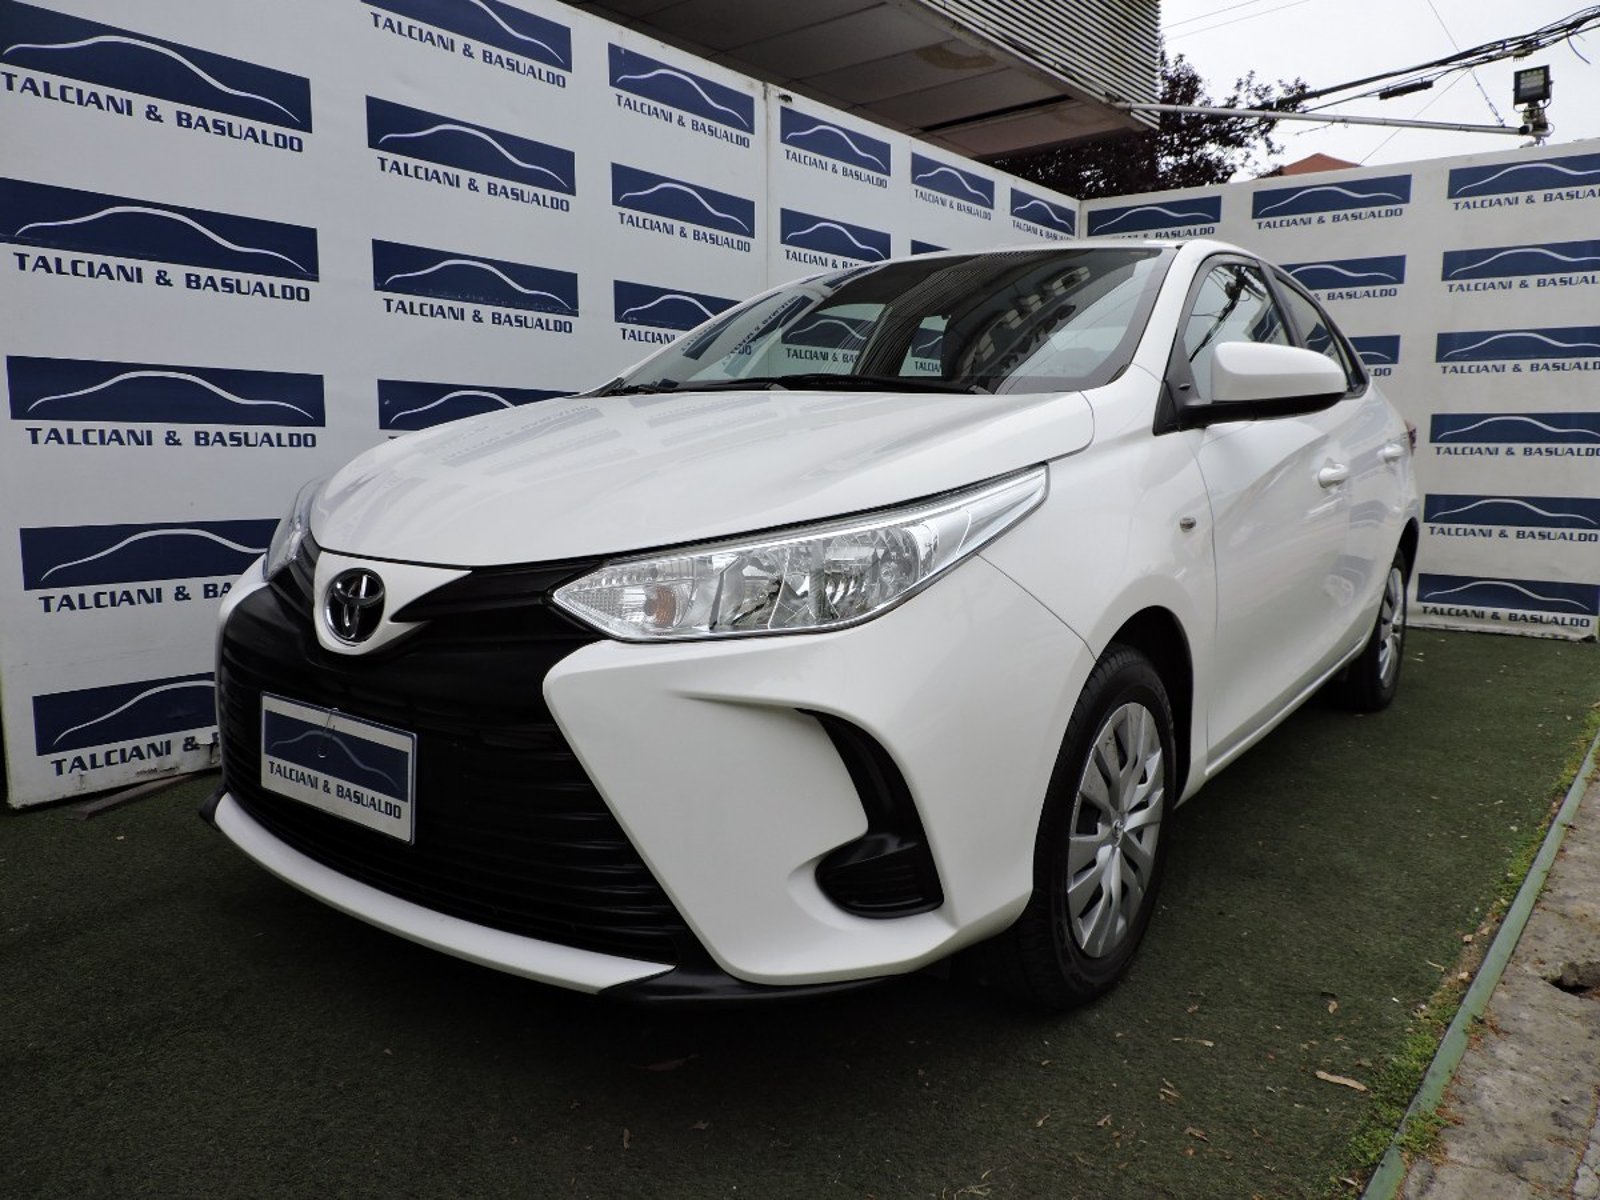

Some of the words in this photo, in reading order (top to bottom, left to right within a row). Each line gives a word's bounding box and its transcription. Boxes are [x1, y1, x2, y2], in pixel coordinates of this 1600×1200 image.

[370, 12, 455, 52] TALCIANI
[462, 43, 475, 59] &
[482, 49, 566, 88] BASUALDO
[1, 72, 133, 116] TALCIANI
[145, 104, 164, 123] &
[175, 110, 304, 153] BASUALDO
[616, 94, 672, 122] TALCIANI
[677, 114, 686, 127] &
[692, 119, 750, 148] BASUALDO
[785, 149, 828, 171] TALCIANI
[831, 164, 838, 174] &
[842, 167, 888, 189] BASUALDO
[377, 157, 460, 188] TALCIANI
[468, 177, 480, 192] &
[487, 182, 570, 212] BASUALDO
[914, 189, 947, 208] TALCIANI
[957, 202, 991, 221] BASUALDO
[1453, 196, 1518, 211] TALCIANI
[1525, 195, 1536, 204] &
[1257, 216, 1312, 230] TALCIANI
[1317, 216, 1326, 225] &
[1332, 207, 1403, 224] BASUALDO
[618, 212, 674, 235] TALCIANI
[679, 227, 688, 238] &
[693, 229, 750, 252] BASUALDO
[1156, 226, 1215, 239] BASUALDO
[785, 249, 827, 267] TALCIANI
[832, 259, 838, 269] &
[13, 252, 143, 284] TALCIANI
[155, 269, 173, 287] &
[185, 272, 310, 302] BASUALDO
[1448, 281, 1512, 293] TALCIANI
[1519, 279, 1529, 289] &
[1327, 287, 1397, 301] BASUALDO
[383, 298, 465, 321] TALCIANI
[472, 310, 484, 323] &
[491, 312, 573, 333] BASUALDO
[786, 347, 829, 361] TALCIANI
[1441, 364, 1506, 374] TALCIANI
[1512, 363, 1522, 373] &
[25, 427, 153, 446] TALCIANI
[164, 430, 182, 446] &
[194, 430, 317, 448] BASUALDO
[1435, 446, 1499, 456] TALCIANI
[1505, 446, 1515, 456] &
[1429, 526, 1492, 538] TALCIANI
[1498, 529, 1508, 538] &
[1516, 530, 1598, 542] BASUALDO
[39, 587, 162, 613] TALCIANI
[174, 585, 191, 601] &
[1422, 606, 1485, 619] TALCIANI
[1491, 611, 1501, 620] &
[1508, 612, 1590, 627] BASUALDO
[51, 740, 171, 777] TALCIANI
[183, 736, 200, 752] &
[269, 761, 318, 789] TALCIANI
[322, 780, 331, 794] &
[336, 784, 402, 819] BASUALDO
